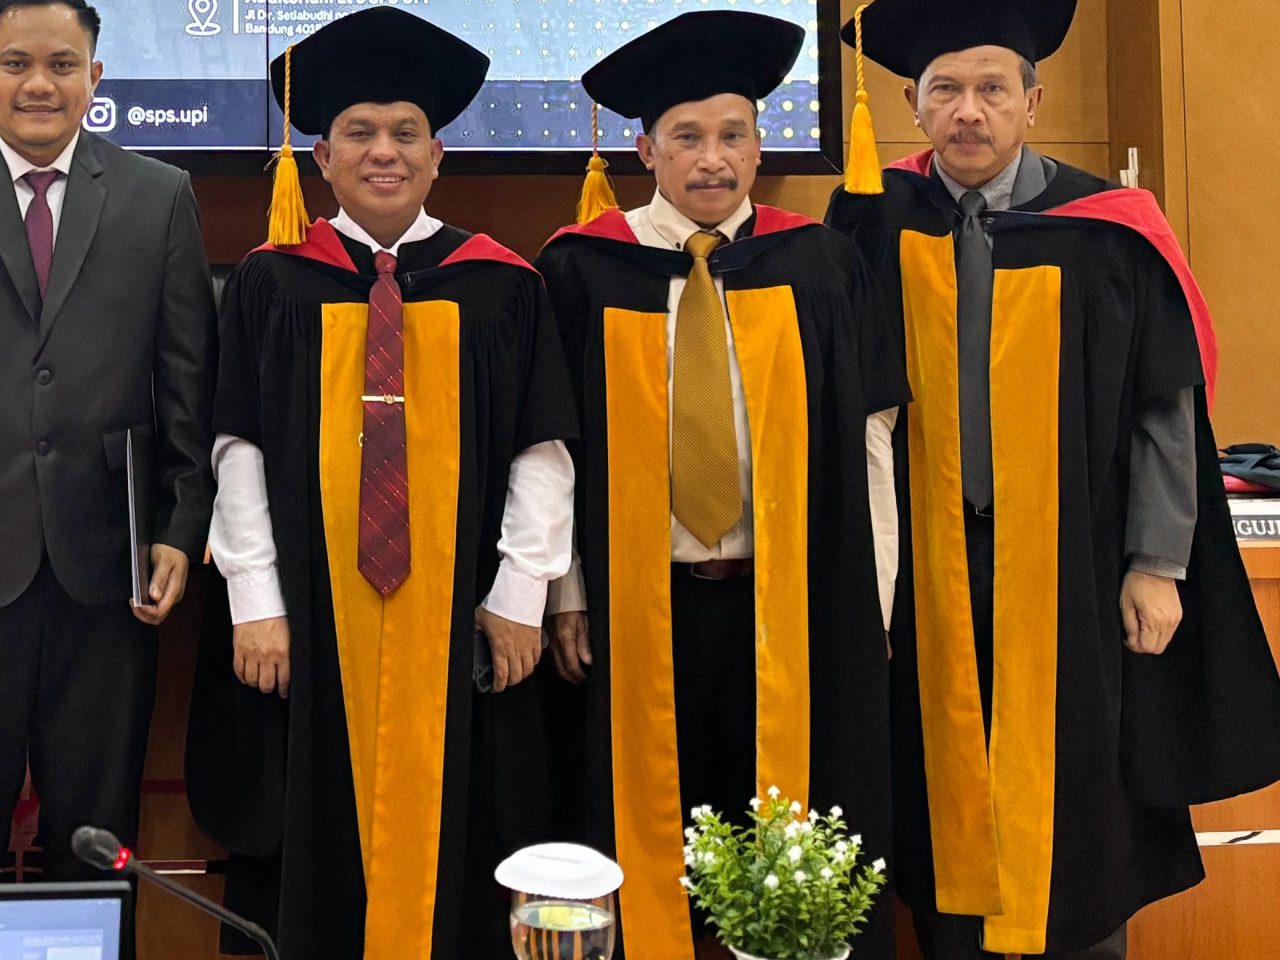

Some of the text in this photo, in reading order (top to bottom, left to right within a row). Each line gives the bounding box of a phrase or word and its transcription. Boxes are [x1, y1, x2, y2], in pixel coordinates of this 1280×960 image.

[276, 10, 333, 21] Setiabudhi
[245, 24, 295, 36] Bandung
[127, 106, 208, 125] @sps.upi
